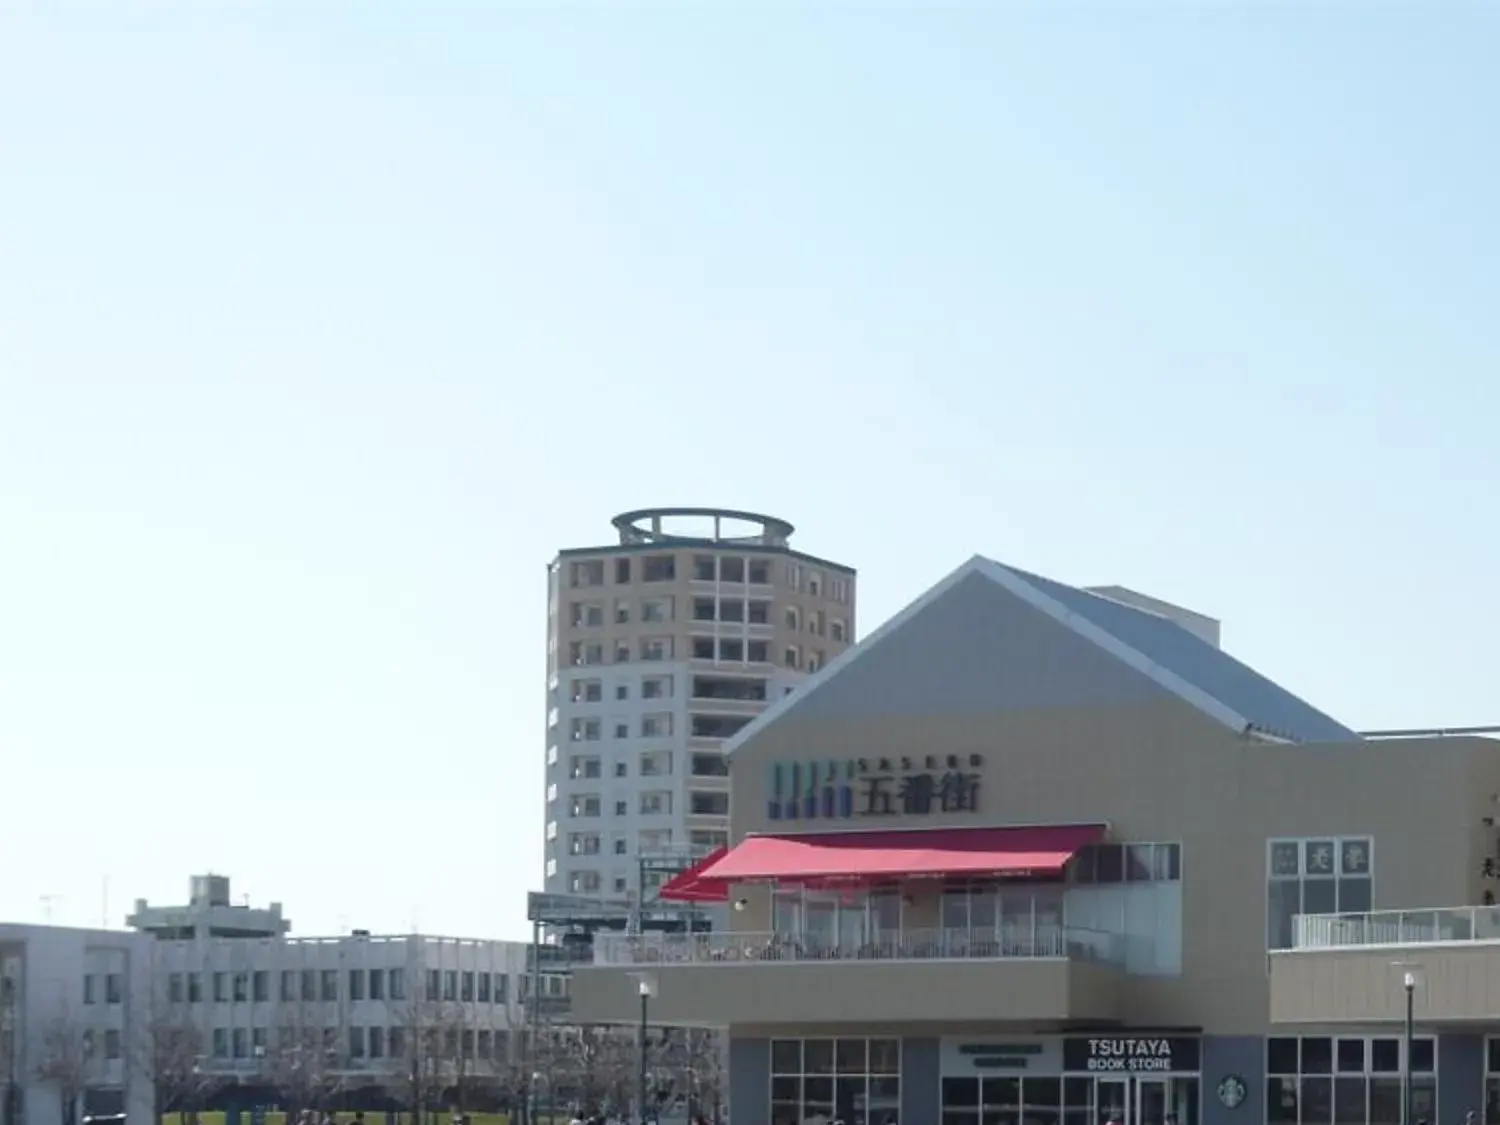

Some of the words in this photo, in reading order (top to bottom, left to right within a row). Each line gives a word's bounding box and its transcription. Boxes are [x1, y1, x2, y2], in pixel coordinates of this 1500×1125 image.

[857, 754, 983, 772] SASEBO
[856, 772, 982, 815] 五番街
[1087, 1039, 1171, 1055] TSUTAYA
[1087, 1058, 1125, 1070] BOOK
[1127, 1058, 1171, 1070] STORE
